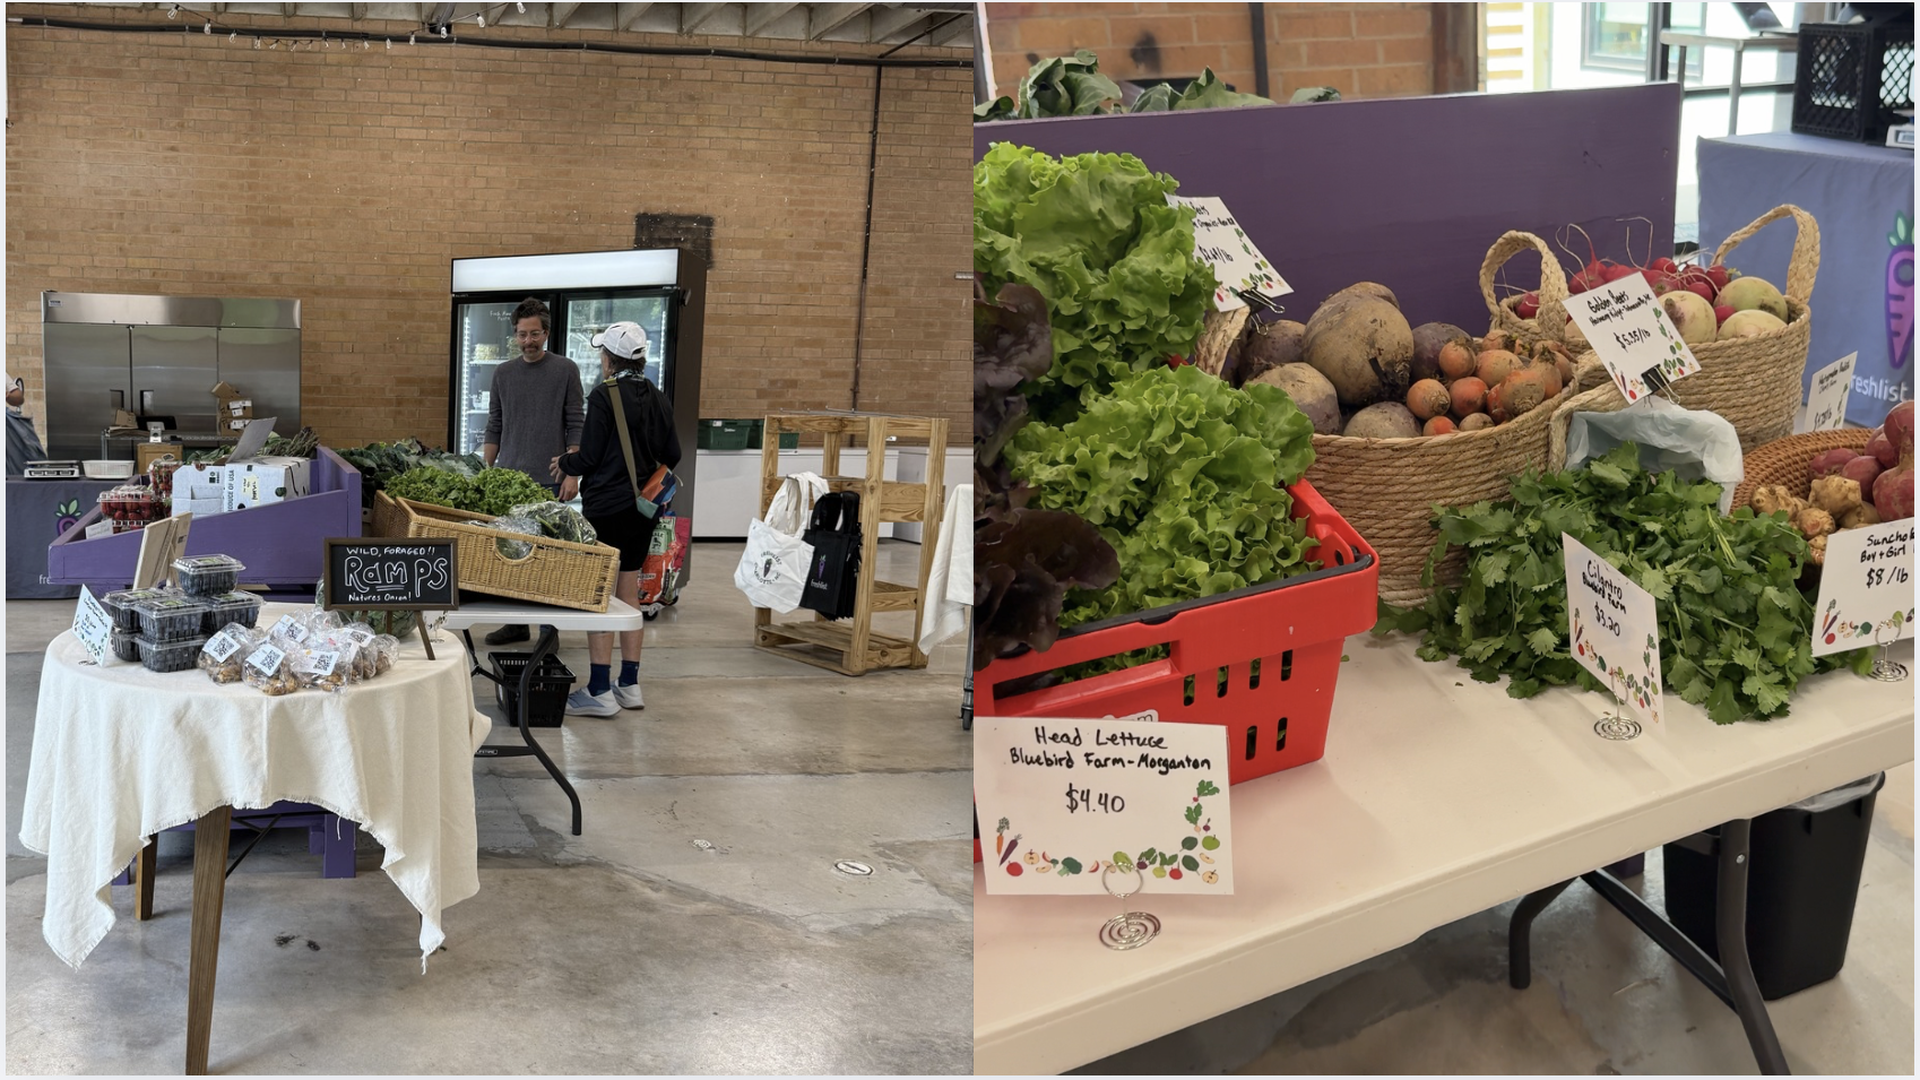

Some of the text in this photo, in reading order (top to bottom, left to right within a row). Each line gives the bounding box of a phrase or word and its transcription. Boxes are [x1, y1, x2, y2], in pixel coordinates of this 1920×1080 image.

[1587, 289, 1630, 314] Golden Beets
[1851, 374, 1909, 403] reshlist
[347, 546, 435, 557] WILD, FORAGED!!
[1860, 549, 1876, 563] Boy
[1886, 544, 1906, 558] Girl
[1587, 560, 1622, 600] Cilantro
[348, 591, 411, 602] Natures Onion!
[1607, 592, 1627, 614] Farm
[1594, 601, 1620, 637] $3.20
[1035, 726, 1168, 749] Head Lettuce
[1010, 747, 1075, 769] Bluebird
[1066, 782, 1126, 814] $4.40
